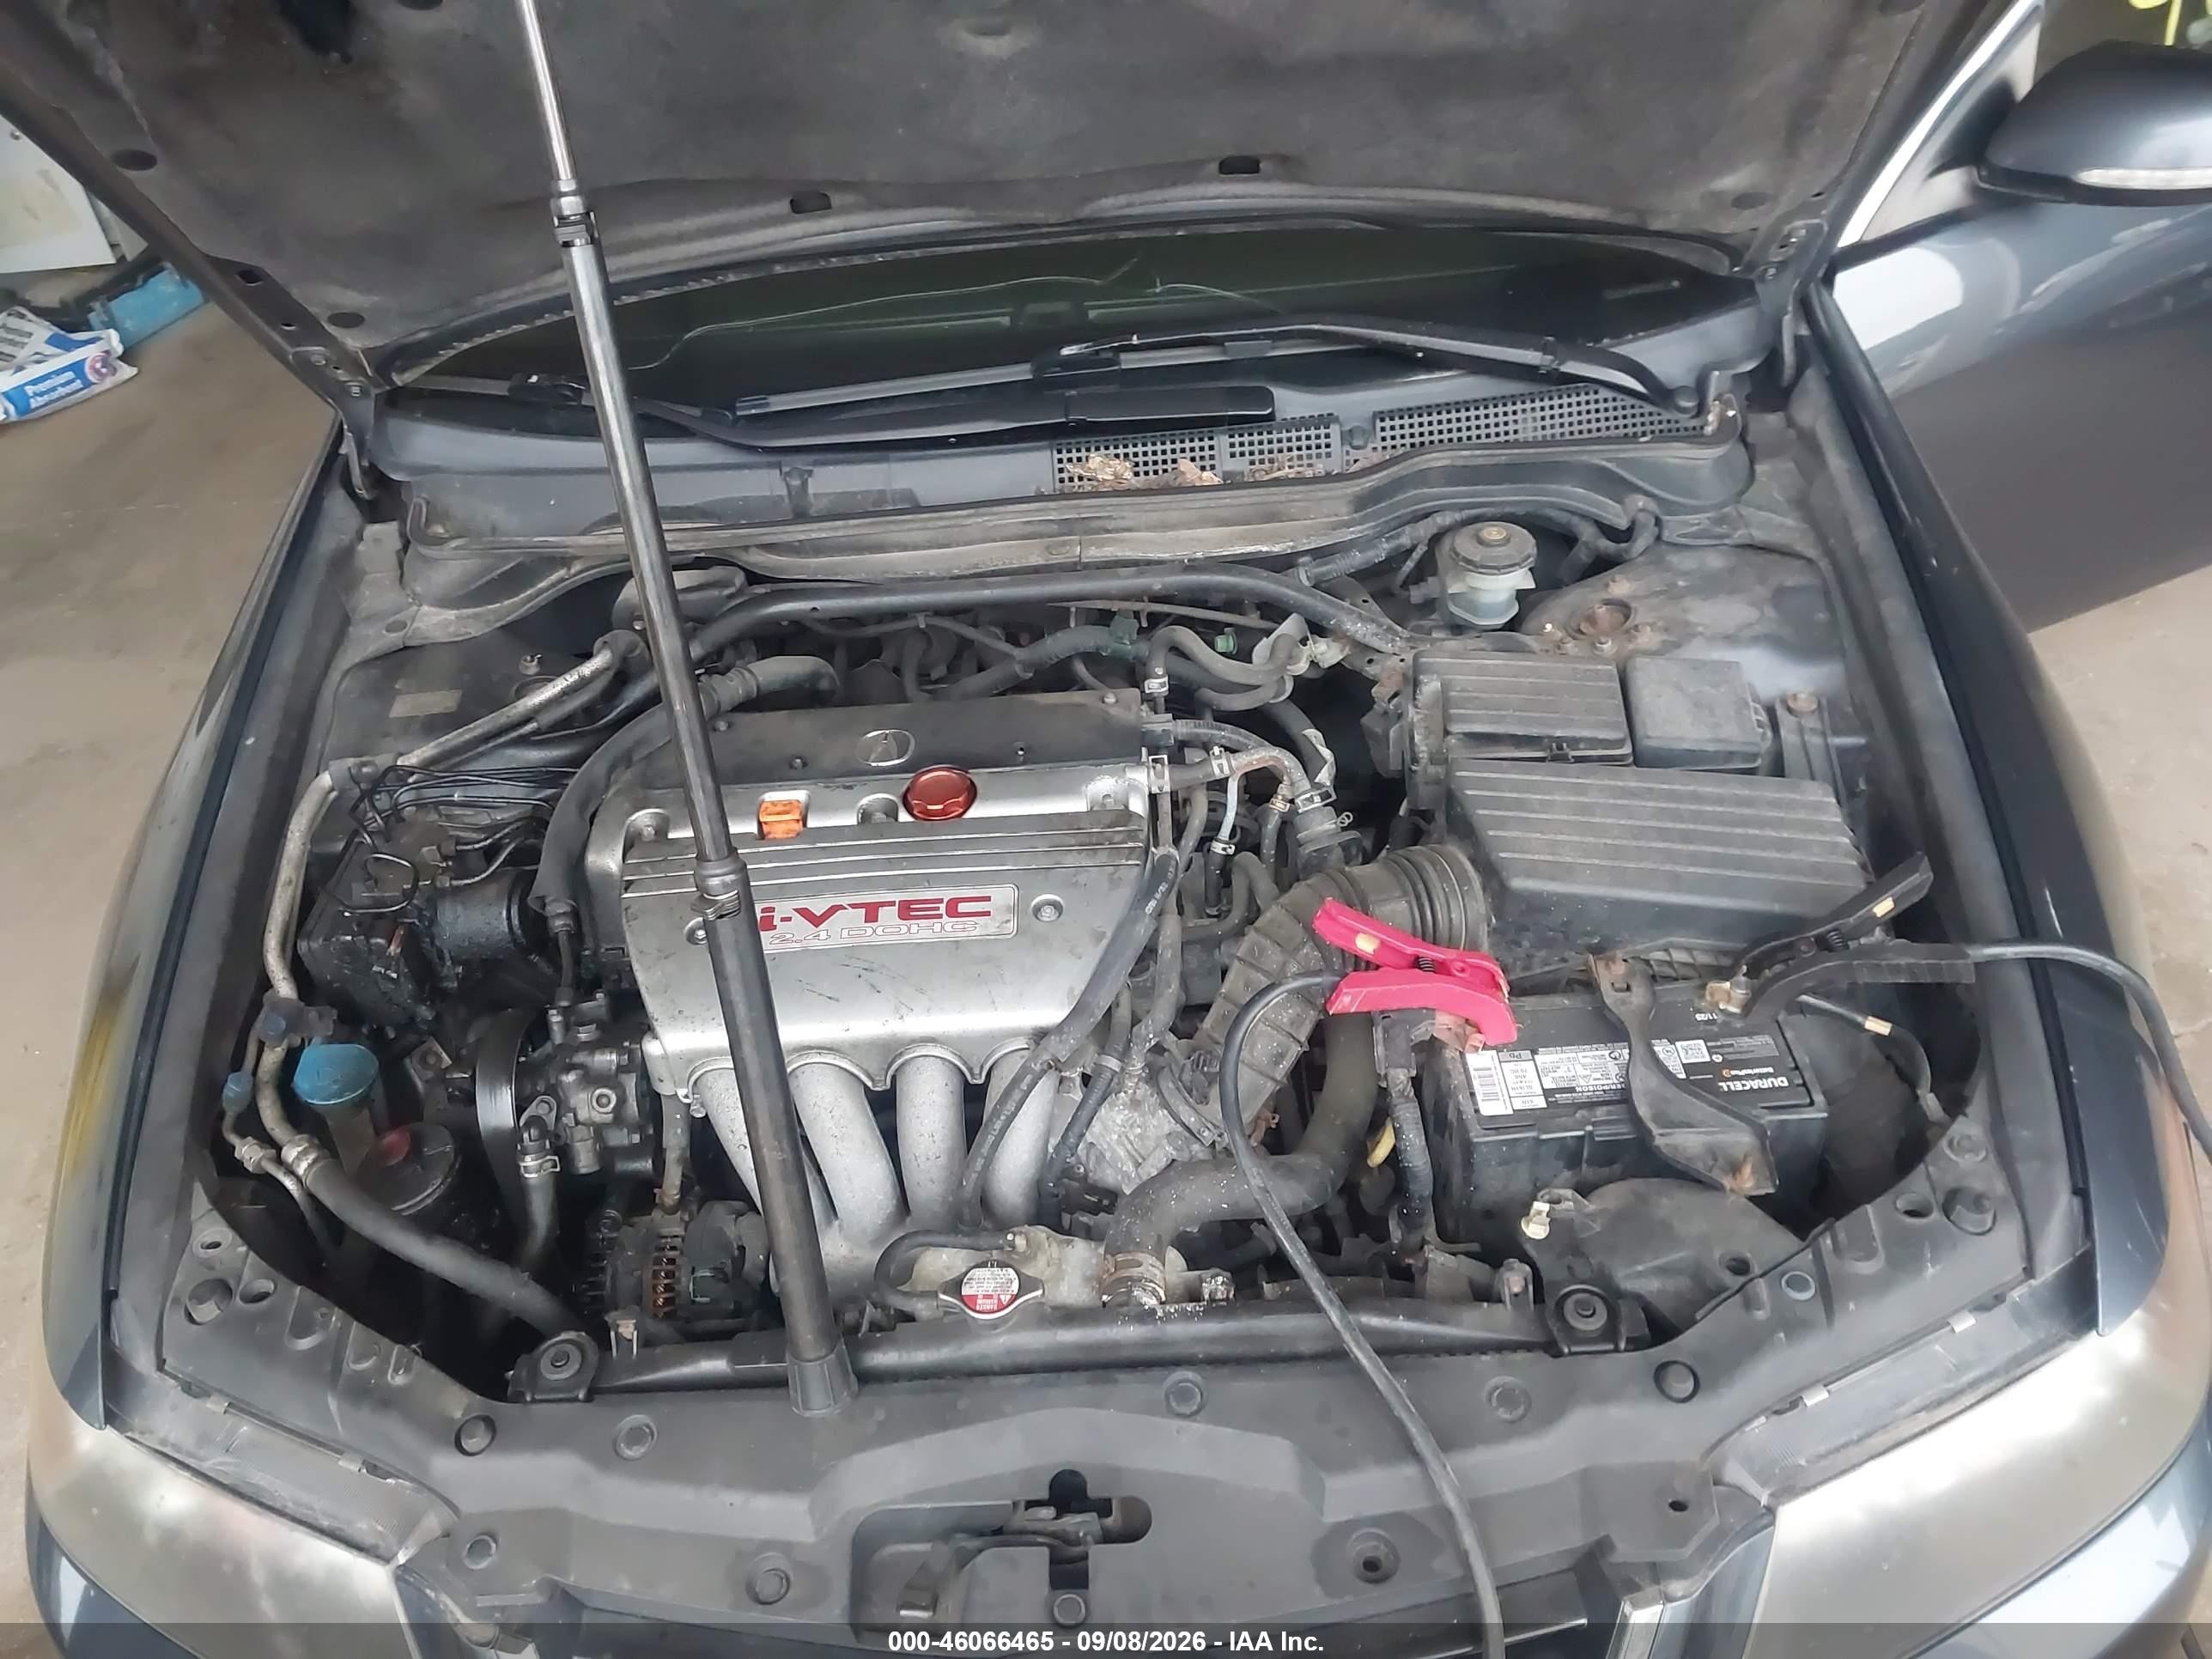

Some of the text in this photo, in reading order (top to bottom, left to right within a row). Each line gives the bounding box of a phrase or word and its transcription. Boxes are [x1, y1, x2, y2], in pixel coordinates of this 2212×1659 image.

[758, 896, 991, 931] i-VTEC
[770, 921, 981, 945] 2.4 DOHC
[1718, 1077, 1789, 1091] DURACELL
